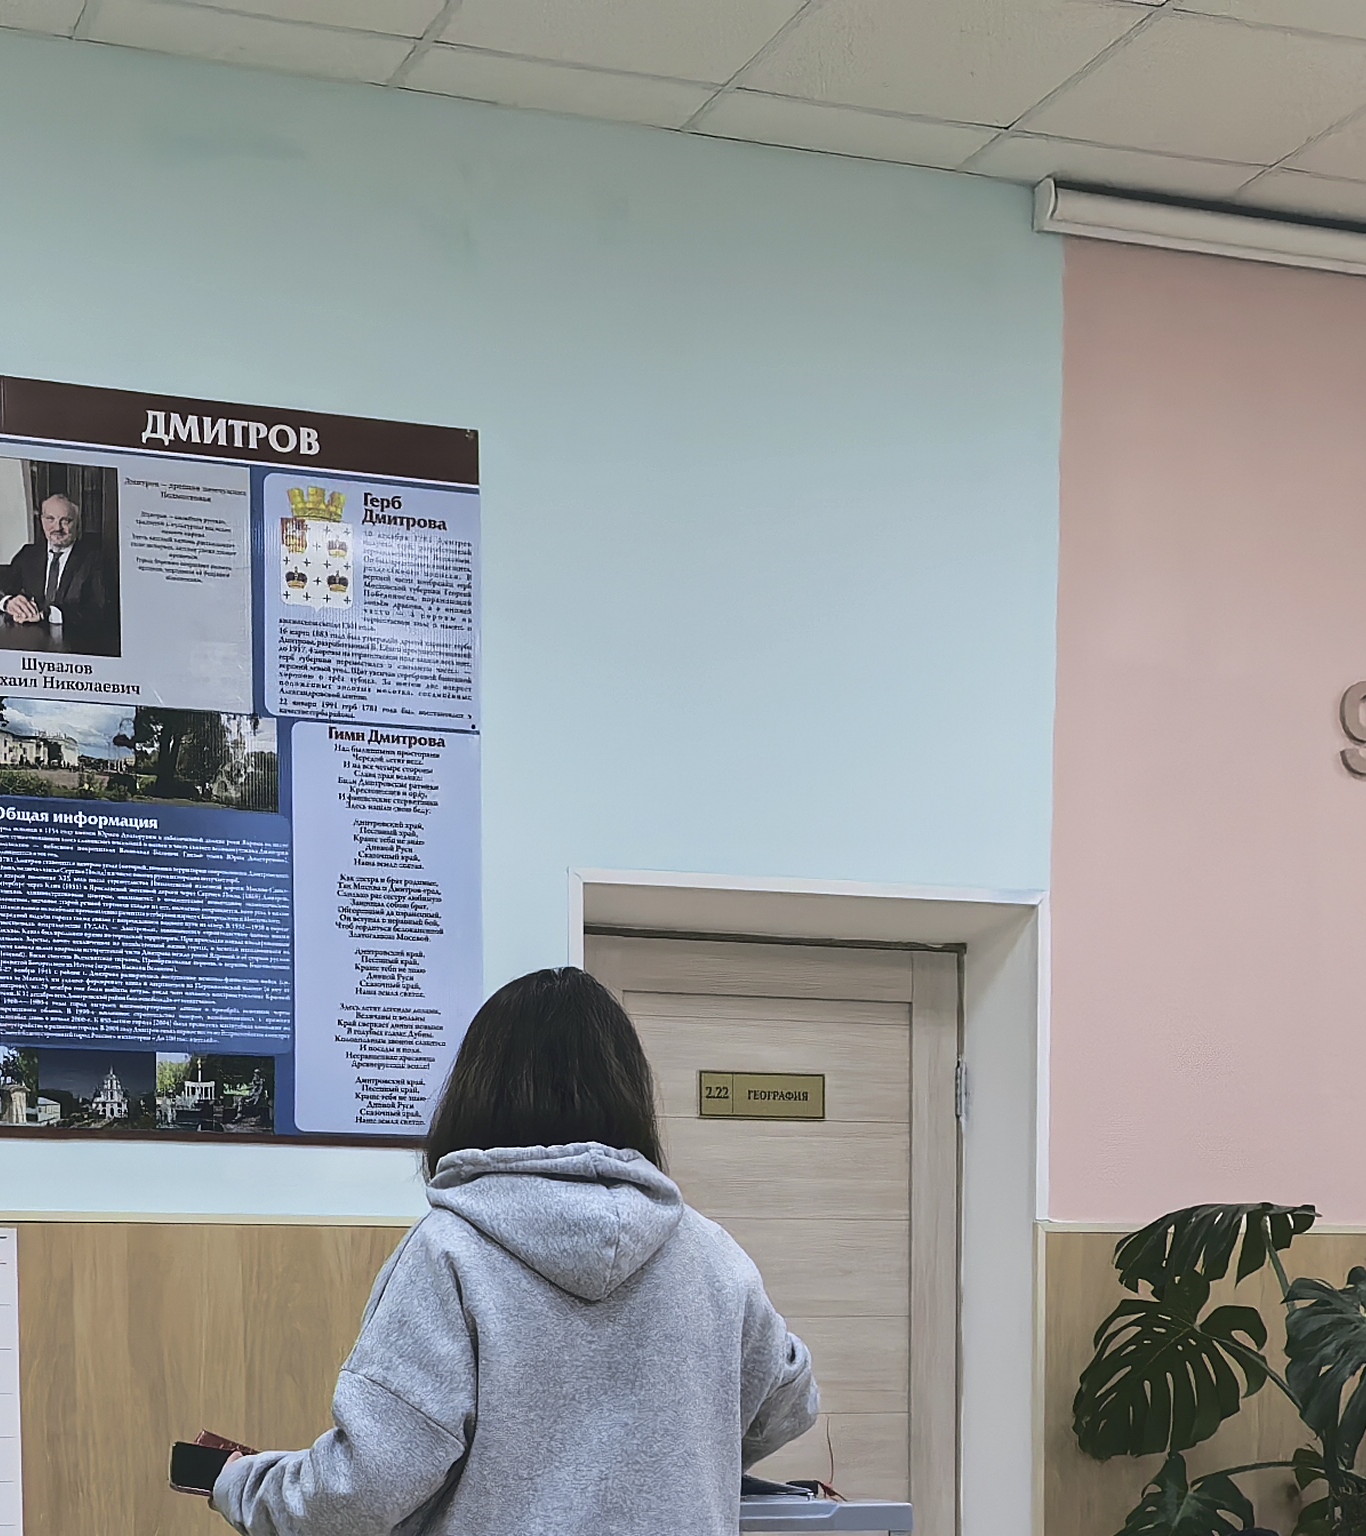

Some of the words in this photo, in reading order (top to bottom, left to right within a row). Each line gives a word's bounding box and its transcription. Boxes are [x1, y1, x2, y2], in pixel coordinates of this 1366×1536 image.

[142, 410, 320, 455] ДМИТРОВ
[363, 492, 403, 510] Герб
[361, 509, 447, 531] Дмитрова
[21, 657, 93, 676] Шувалов
[43, 676, 141, 696] Николаевич
[328, 727, 365, 742] Гимн
[367, 729, 445, 749] Дмитрова
[53, 810, 158, 829] информация
[705, 1087, 729, 1098] 2.22
[747, 1090, 809, 1101] ГЕОГРАФИЯ
